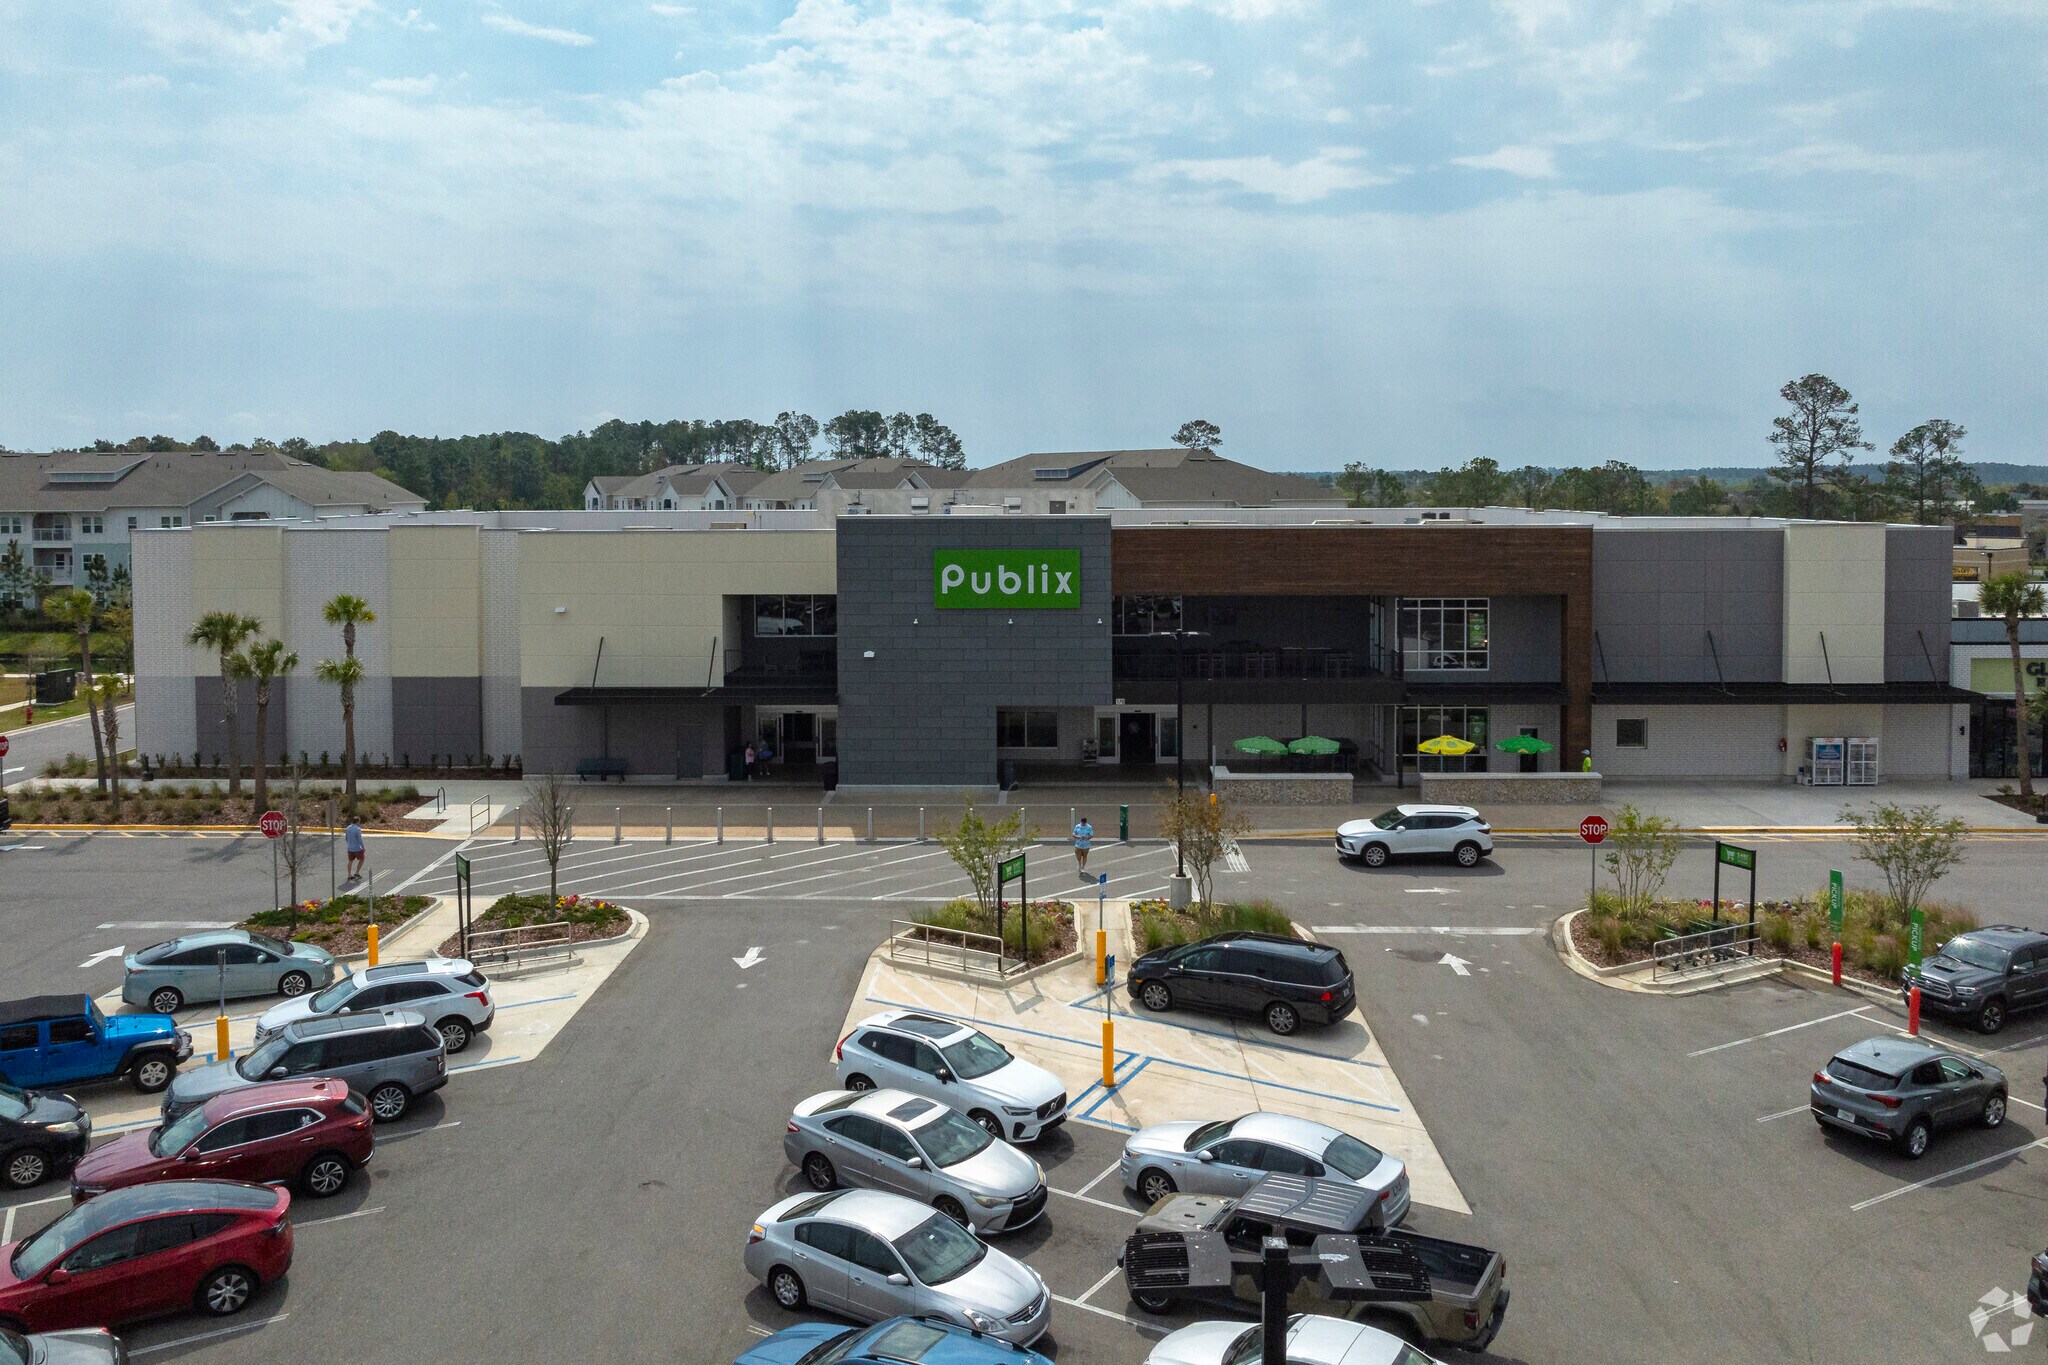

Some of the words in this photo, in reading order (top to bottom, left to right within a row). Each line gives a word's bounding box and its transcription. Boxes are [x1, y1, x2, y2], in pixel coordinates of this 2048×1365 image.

[942, 563, 1072, 595] Publix
[262, 820, 286, 831] STOP
[1581, 824, 1607, 836] STOP
[1911, 922, 1919, 952] PICKUP
